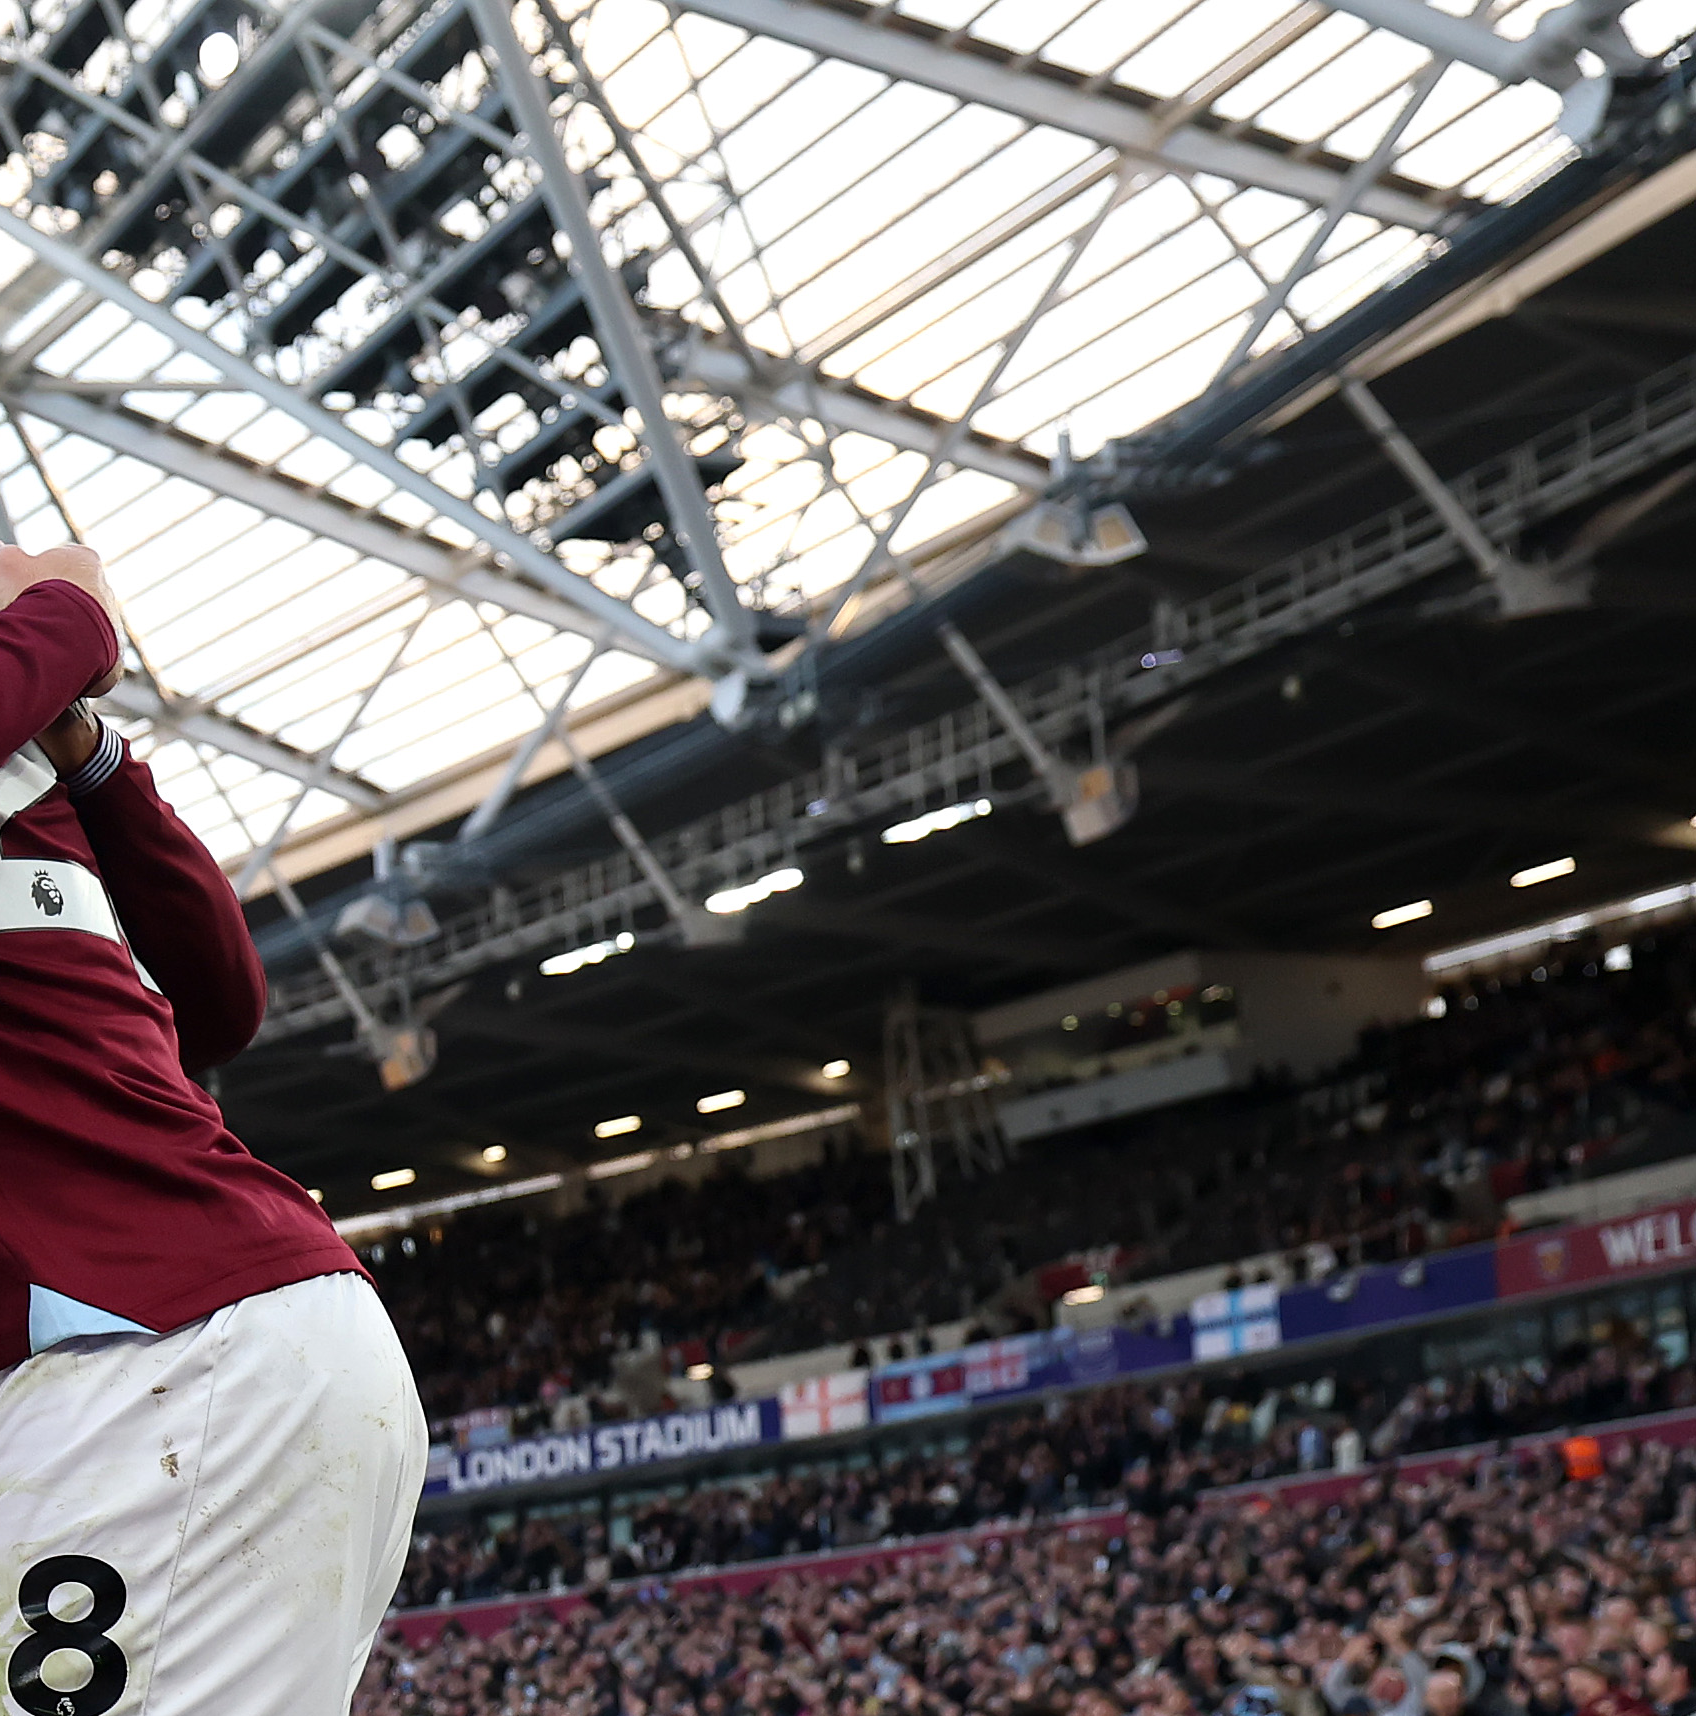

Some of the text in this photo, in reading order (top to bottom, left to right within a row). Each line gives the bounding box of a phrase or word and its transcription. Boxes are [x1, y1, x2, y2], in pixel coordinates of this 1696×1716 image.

[1598, 1209, 1696, 1268] WEL
[447, 1401, 761, 1493] LONDON STADIUM
